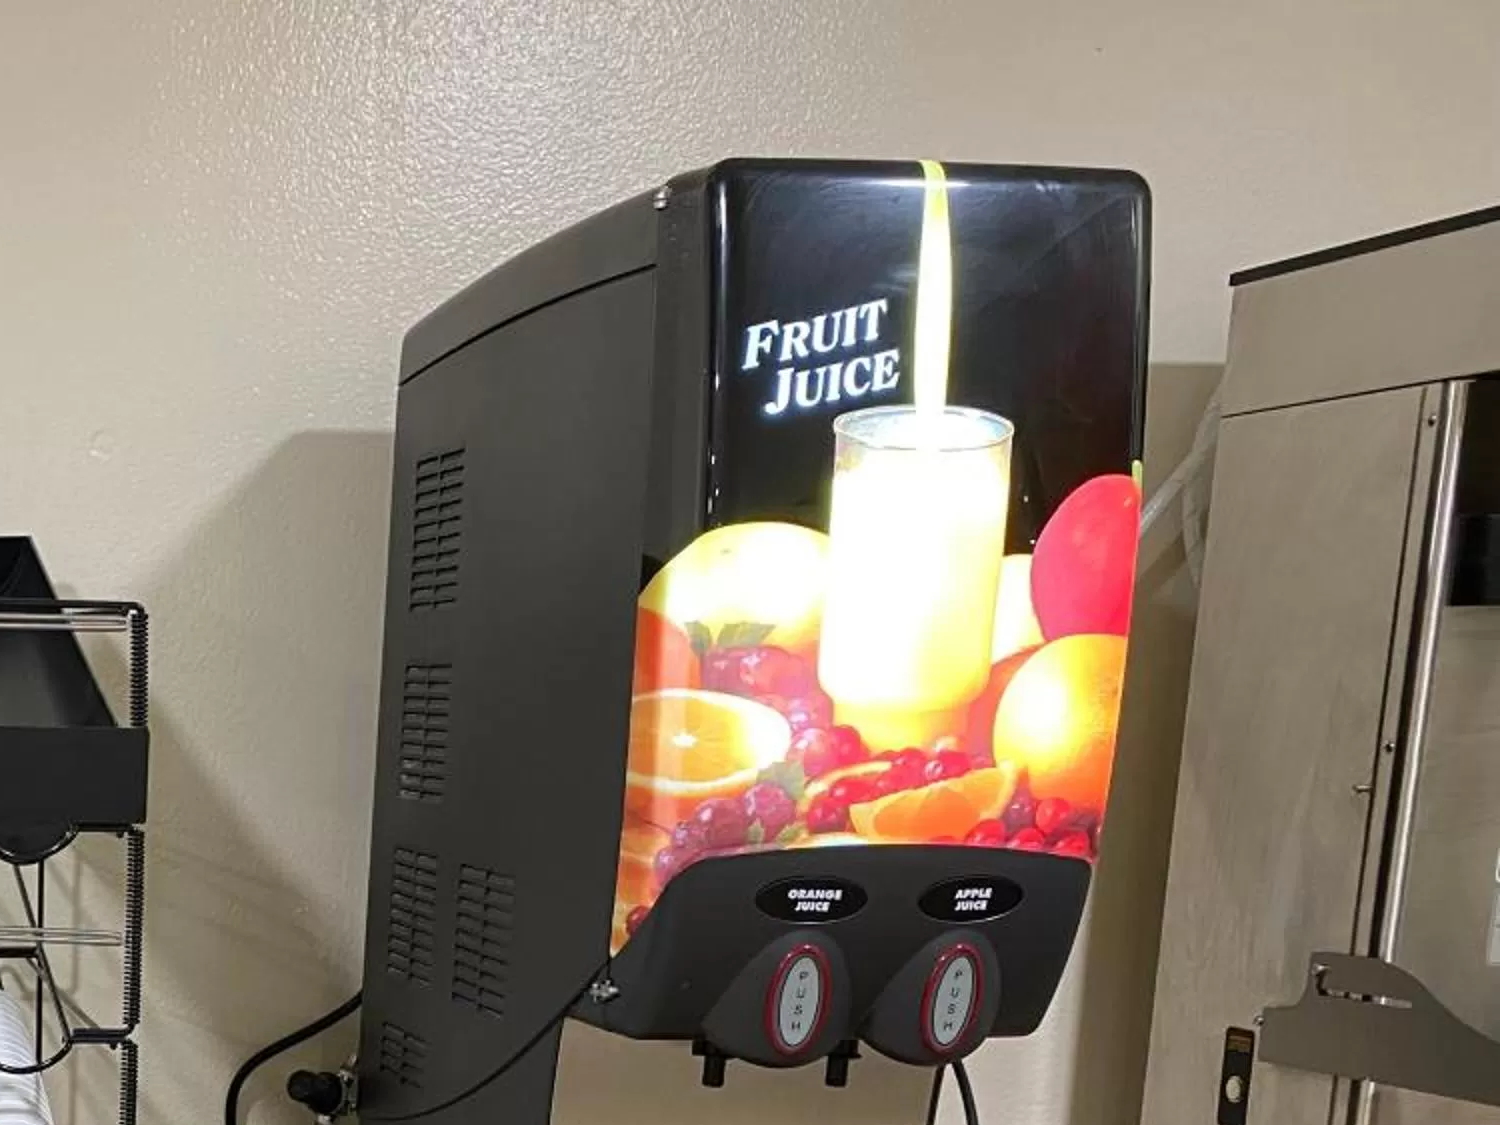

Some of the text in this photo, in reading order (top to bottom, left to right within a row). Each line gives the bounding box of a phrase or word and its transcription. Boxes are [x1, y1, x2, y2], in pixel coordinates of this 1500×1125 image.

[741, 298, 888, 371] FRUIT
[764, 348, 900, 415] JUICE
[787, 889, 843, 900] ORANGE
[795, 901, 830, 912] JUICE
[954, 900, 988, 911] JUICE
[955, 887, 992, 899] APPLE
[791, 971, 810, 1030] PUSH
[943, 970, 963, 1031] PUSH
